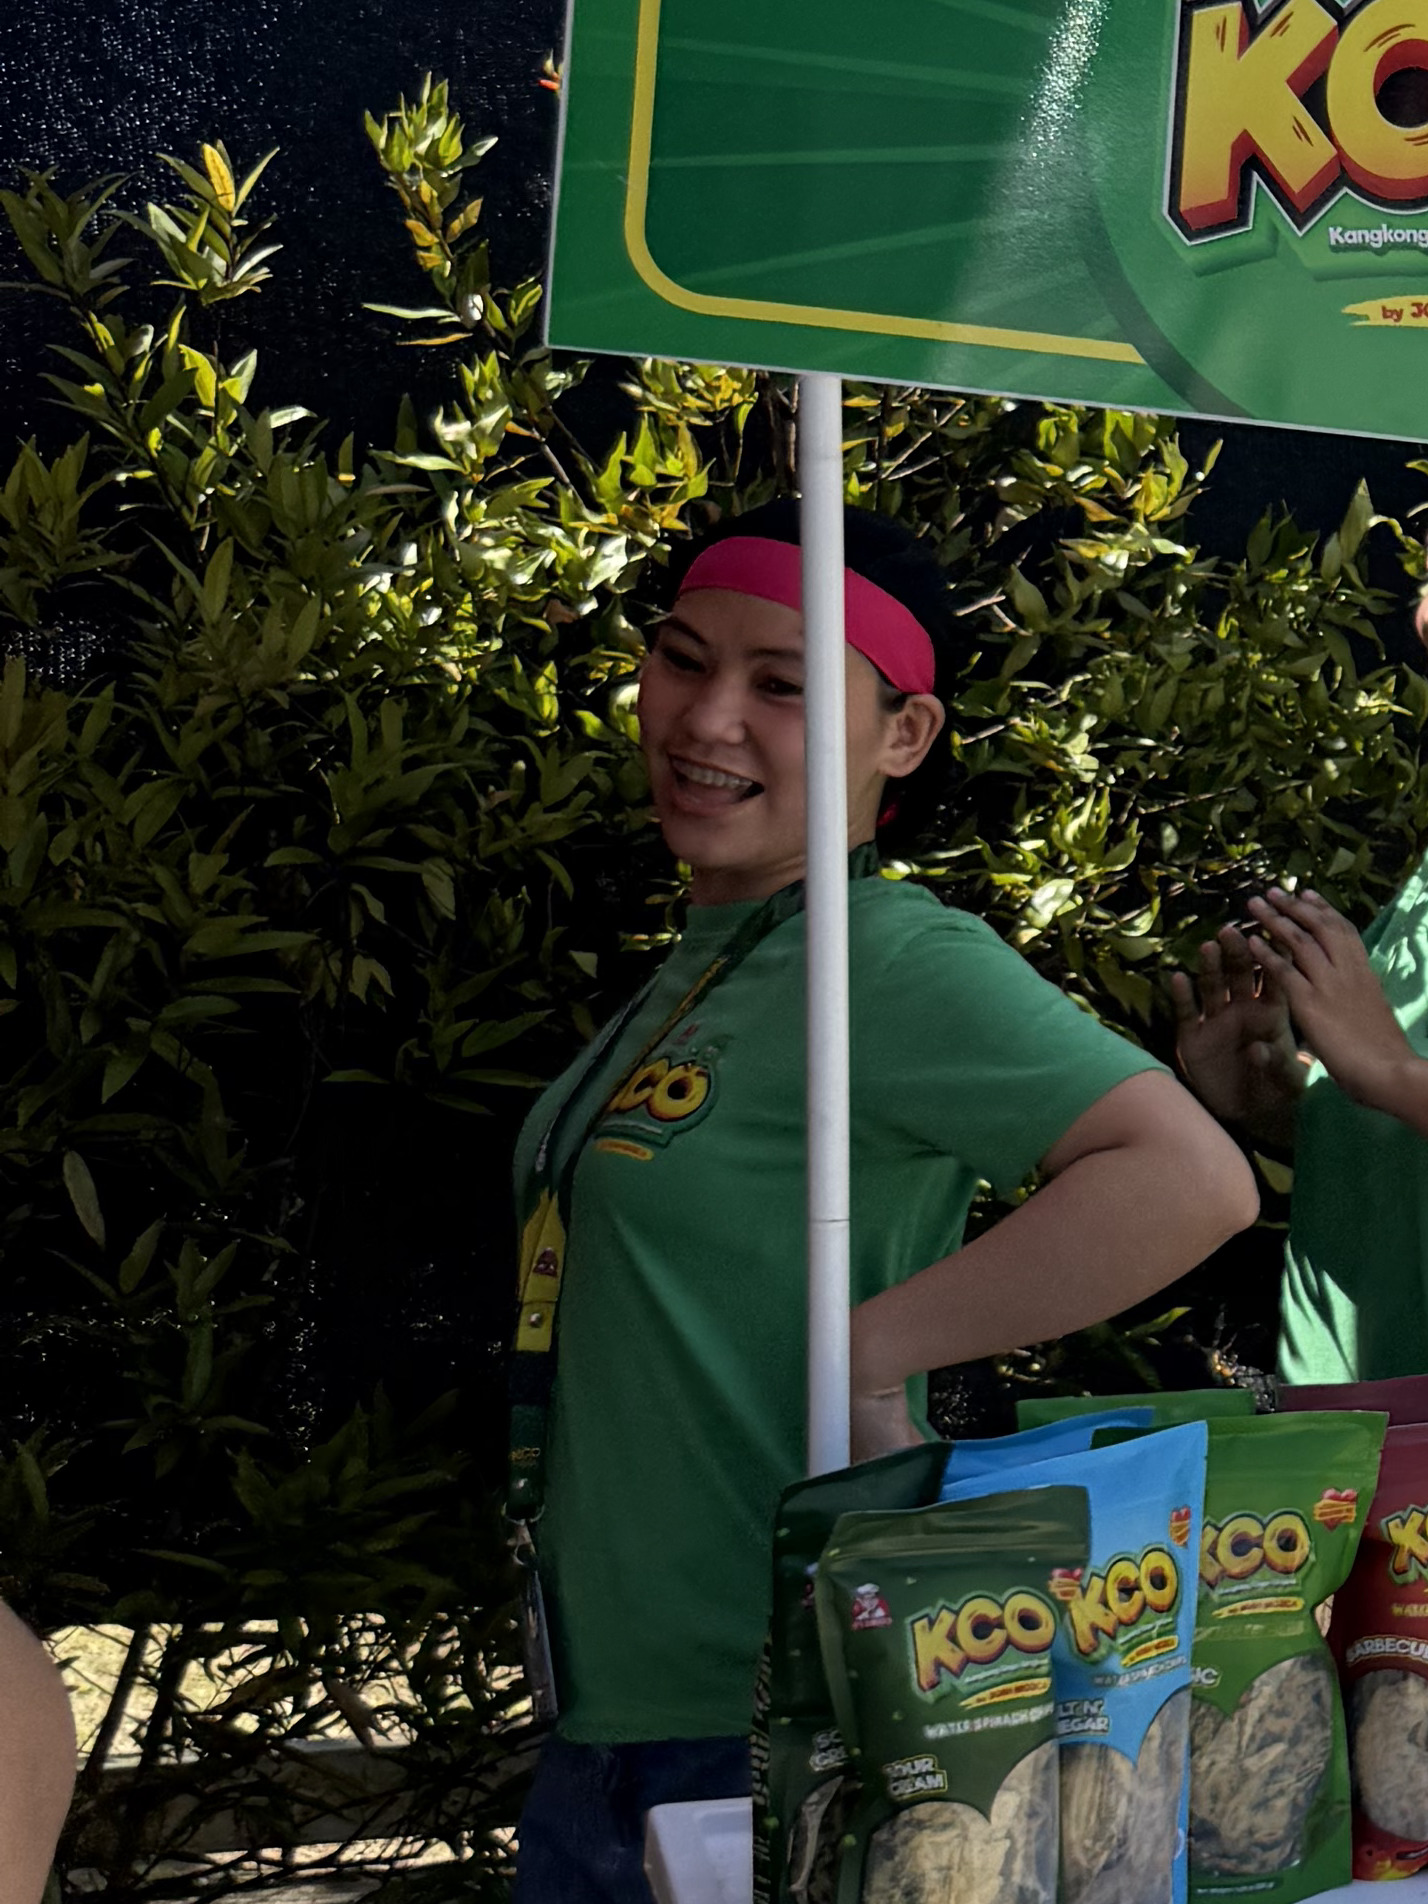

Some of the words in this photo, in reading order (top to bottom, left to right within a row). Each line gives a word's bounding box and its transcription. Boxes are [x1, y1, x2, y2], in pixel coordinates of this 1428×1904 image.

[1381, 305, 1404, 322] by
[605, 1057, 711, 1122] CO
[1068, 1548, 1177, 1654] KCO
[911, 1593, 1057, 1693] KCO
[1056, 1716, 1109, 1734] EGAR
